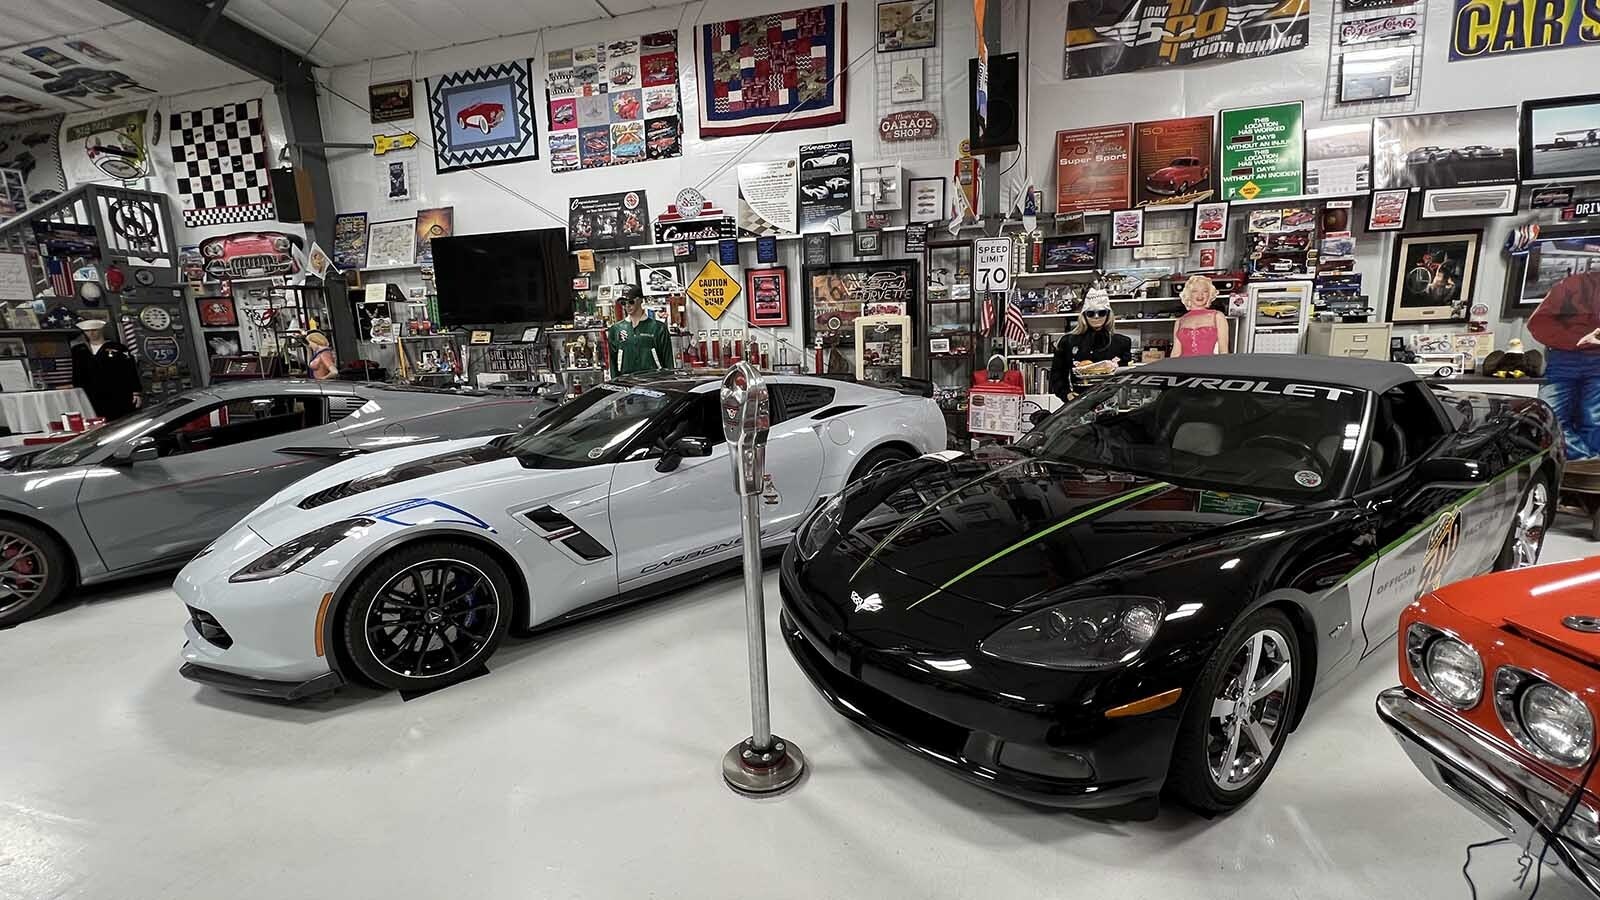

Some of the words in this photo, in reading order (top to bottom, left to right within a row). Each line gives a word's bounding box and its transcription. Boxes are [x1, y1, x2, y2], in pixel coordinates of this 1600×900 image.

[1143, 6, 1169, 18] INDY
[1192, 42, 1234, 58] 100TH
[1236, 33, 1303, 54] RUNNING
[882, 118, 932, 132] GARAGE
[1244, 121, 1279, 129] LOCATION
[1254, 126, 1286, 134] WORKED
[893, 128, 921, 138] SHOP
[800, 142, 838, 152] CARBON
[1060, 157, 1092, 165] Super
[1095, 153, 1128, 162] Sport
[1244, 153, 1279, 161] LOCATION
[1254, 158, 1280, 166] WORK
[1223, 174, 1255, 182] WITHOUT
[1268, 170, 1300, 178] INCIDENT
[978, 246, 1008, 254] SPEED
[978, 267, 1006, 283] 70
[699, 278, 728, 288] CAUTION
[704, 288, 724, 297] SPEED
[853, 289, 913, 302] CORVETTE
[704, 298, 724, 306] BUMP
[490, 350, 506, 360] STILL
[507, 350, 524, 360] PLAYS
[492, 360, 507, 370] WITH
[508, 360, 525, 370] CARS
[1104, 374, 1354, 402] CHEVROLET
[1377, 565, 1416, 594] OFFICIAL
